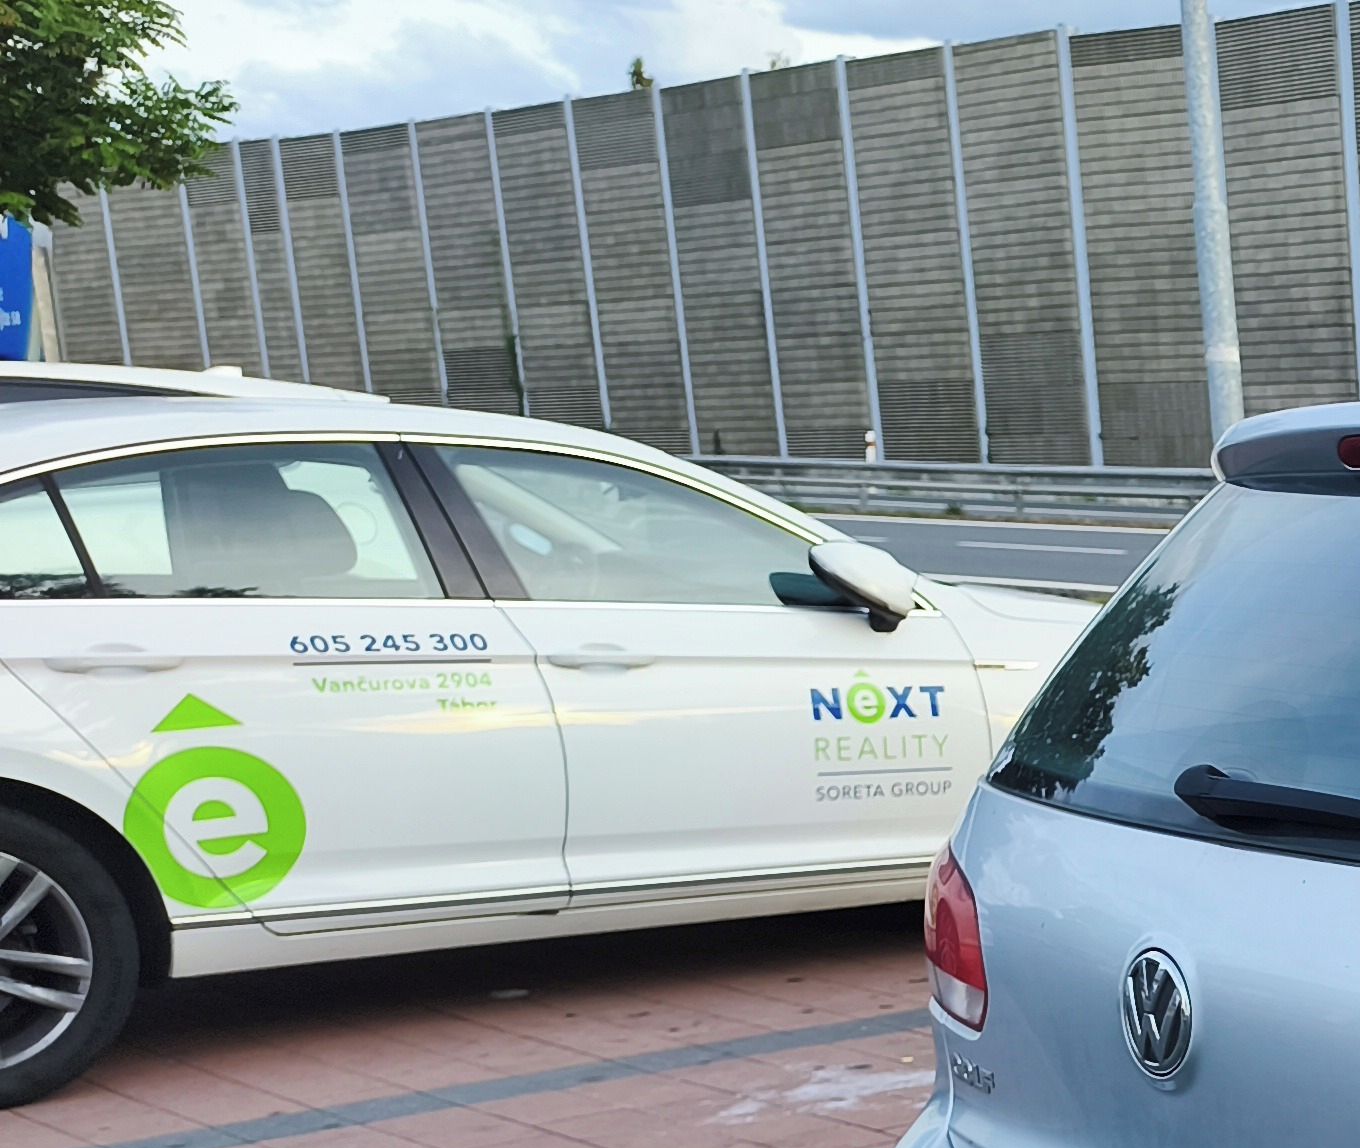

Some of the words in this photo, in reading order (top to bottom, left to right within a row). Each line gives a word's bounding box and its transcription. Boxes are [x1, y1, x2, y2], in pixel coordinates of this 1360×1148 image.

[290, 634, 351, 654] 605
[360, 634, 421, 652] 245
[429, 633, 488, 651] 300
[311, 675, 431, 694] Vančurova
[436, 672, 492, 690] 2904
[814, 734, 949, 762] REALITY
[816, 783, 885, 802] SORETA
[891, 780, 953, 798] GROUP
